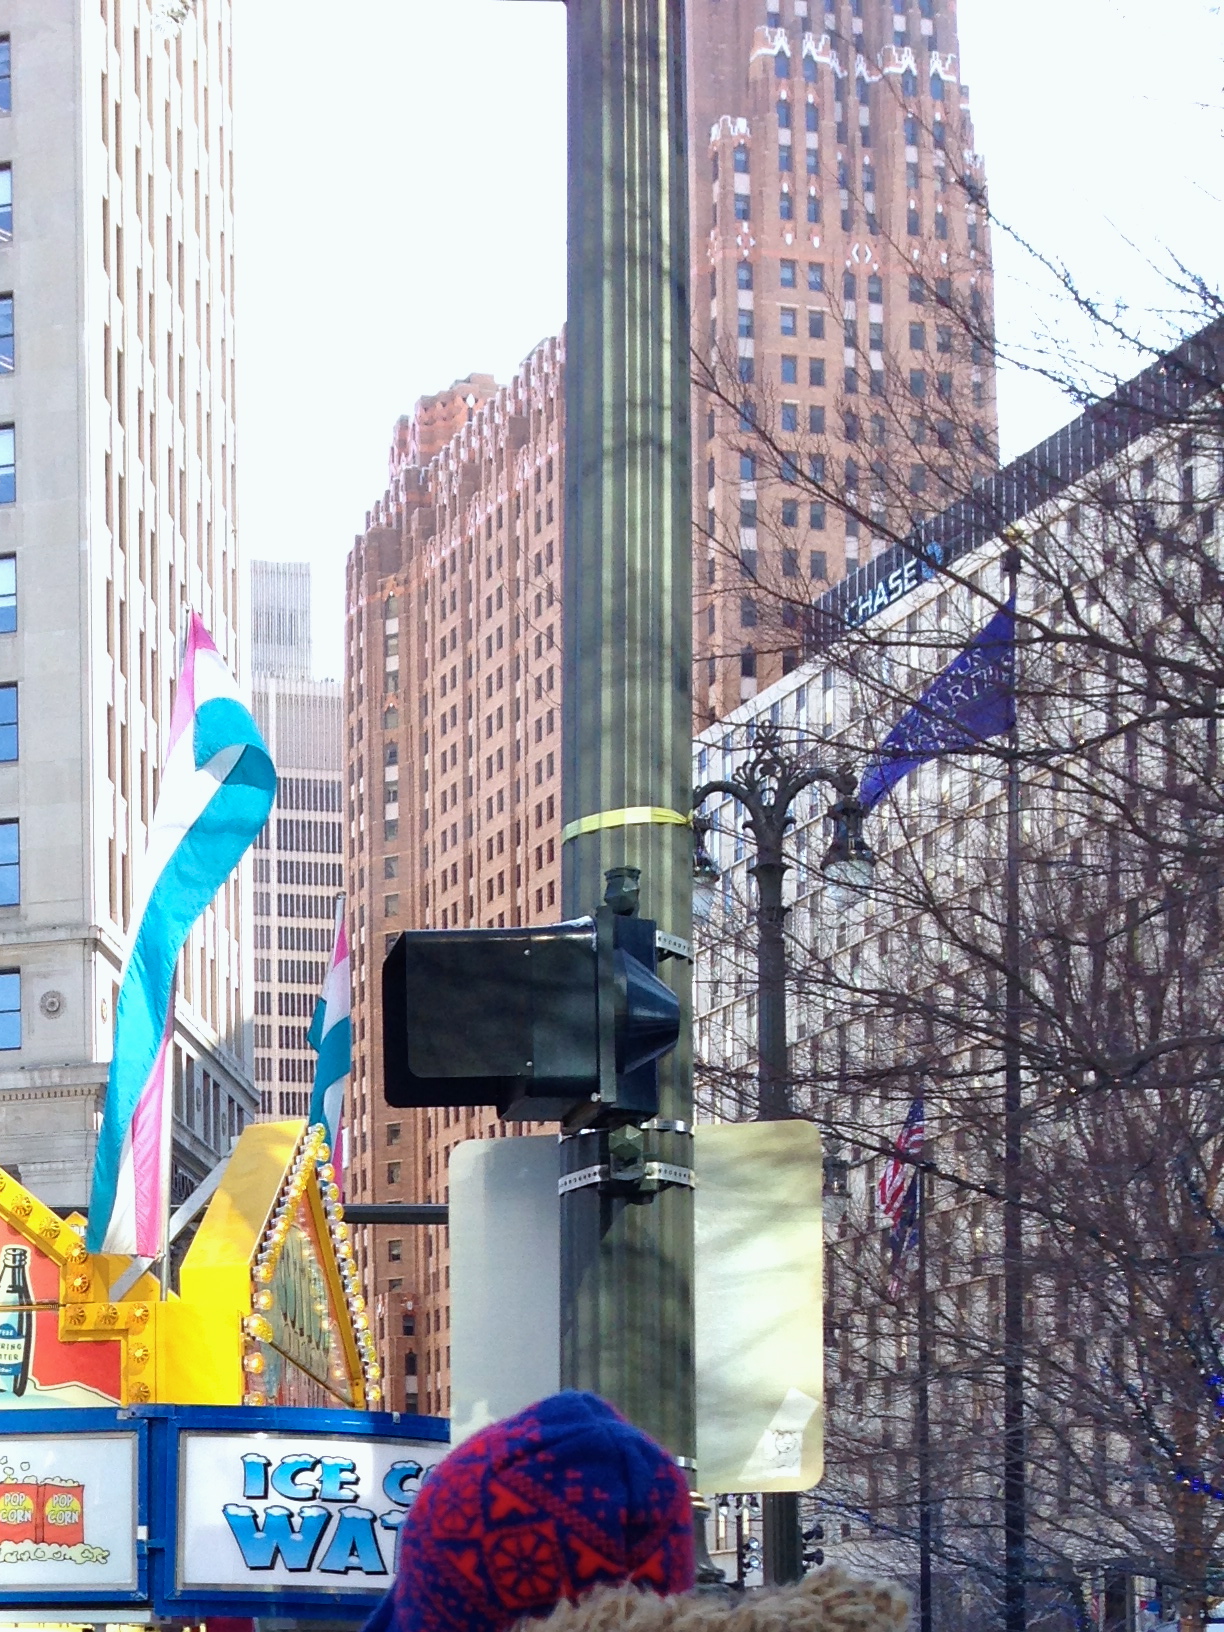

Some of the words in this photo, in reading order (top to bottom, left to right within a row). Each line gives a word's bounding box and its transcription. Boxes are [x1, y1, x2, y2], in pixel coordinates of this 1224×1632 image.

[844, 558, 918, 628] CHASE
[240, 1452, 360, 1503] ICE
[4, 1492, 25, 1506] POP
[52, 1494, 73, 1507] POP
[47, 1509, 79, 1524] CORN
